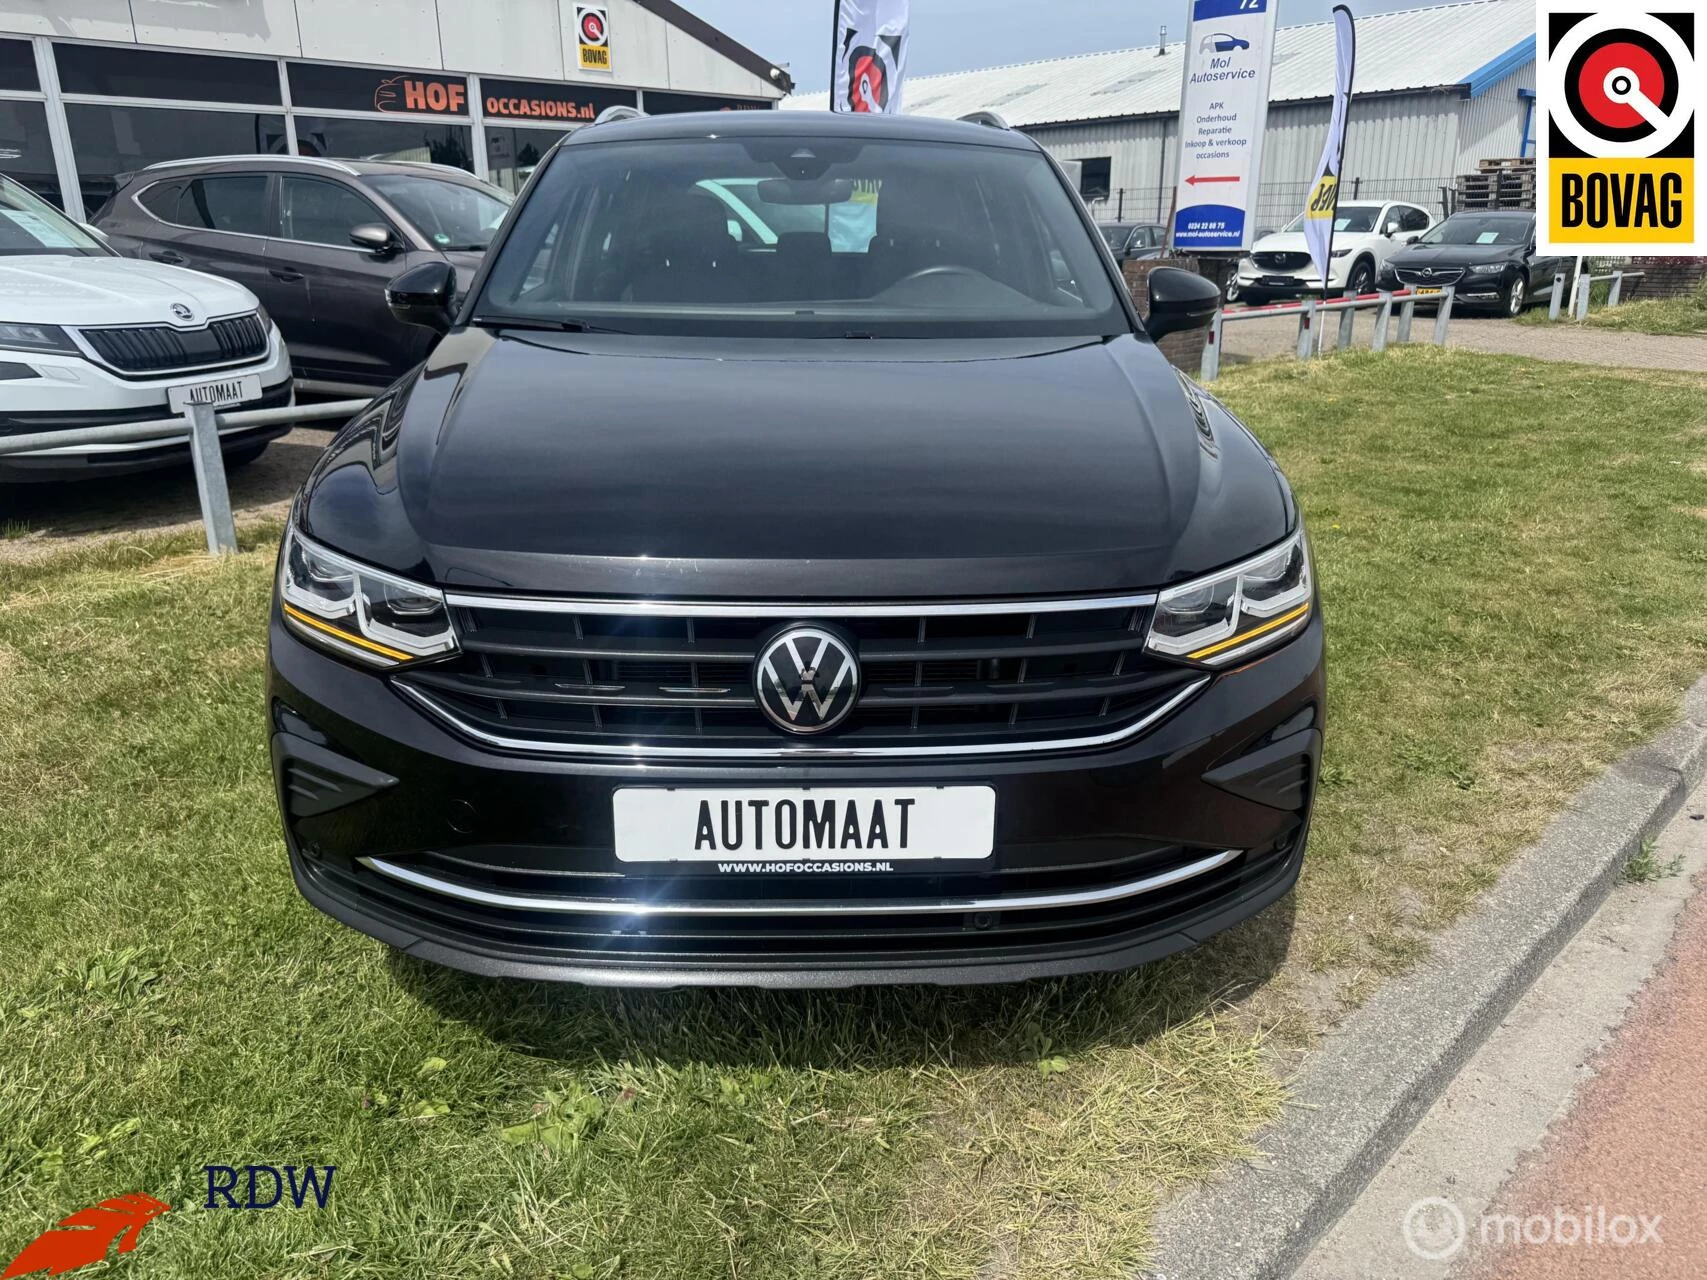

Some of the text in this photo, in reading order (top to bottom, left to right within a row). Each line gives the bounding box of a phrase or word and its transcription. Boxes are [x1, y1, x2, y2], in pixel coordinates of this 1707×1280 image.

[582, 48, 608, 64] BOVAG
[1210, 57, 1231, 70] Mol
[1189, 68, 1256, 84] Autoservice
[404, 80, 595, 119] HOF OCCASIONS.nl
[1209, 102, 1224, 110] APK
[1196, 113, 1237, 123] Onderhoud
[1198, 126, 1232, 136] Reparatie
[1208, 139, 1214, 147] &
[1215, 138, 1247, 148] verkoop
[1196, 151, 1230, 160] occasions
[190, 381, 242, 402] AUTOMAAT
[694, 798, 915, 850] AUTOMAAT
[718, 862, 894, 873] WWW.HOFOCCASIONS.NL
